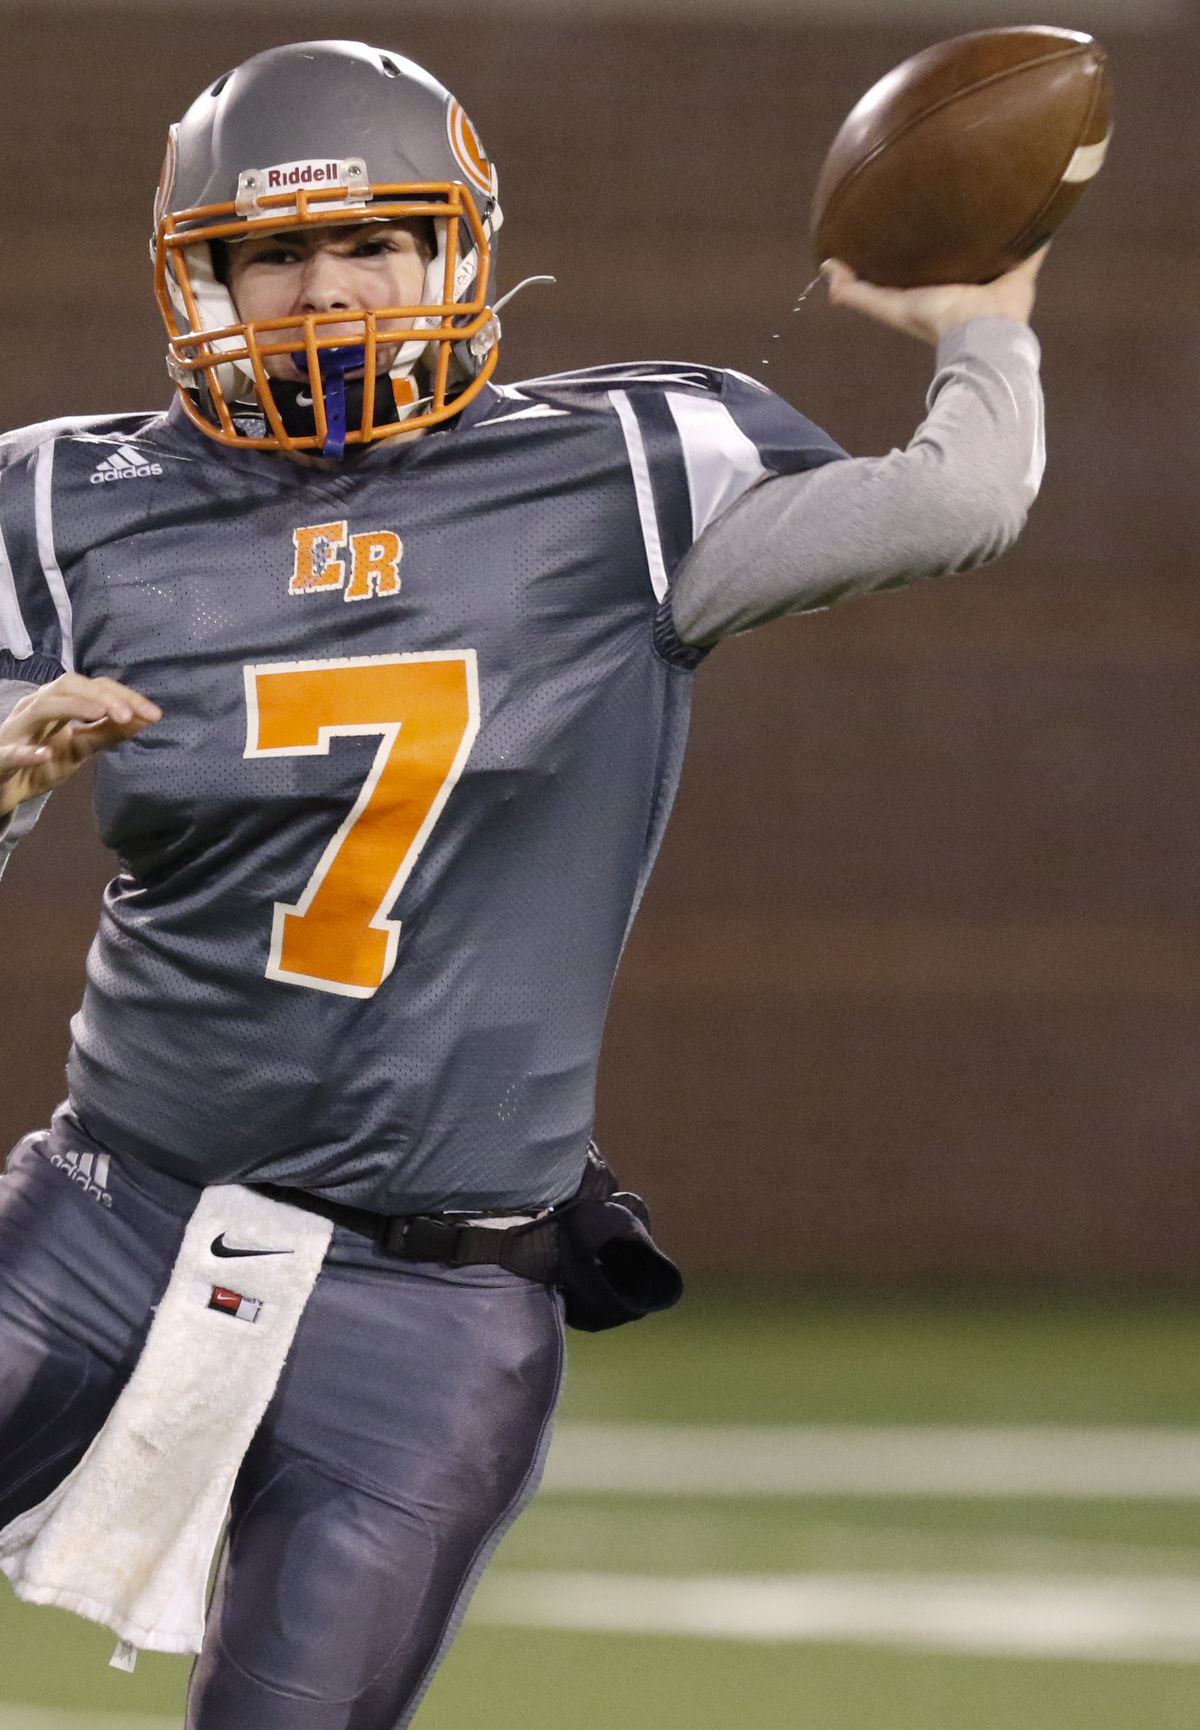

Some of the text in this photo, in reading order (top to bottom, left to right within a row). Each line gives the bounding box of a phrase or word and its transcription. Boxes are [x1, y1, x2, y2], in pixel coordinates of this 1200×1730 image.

[268, 163, 338, 188] Riddell
[89, 463, 163, 484] adidas
[288, 520, 403, 603] ER
[242, 648, 481, 999] 7
[50, 1154, 113, 1208] adidas
